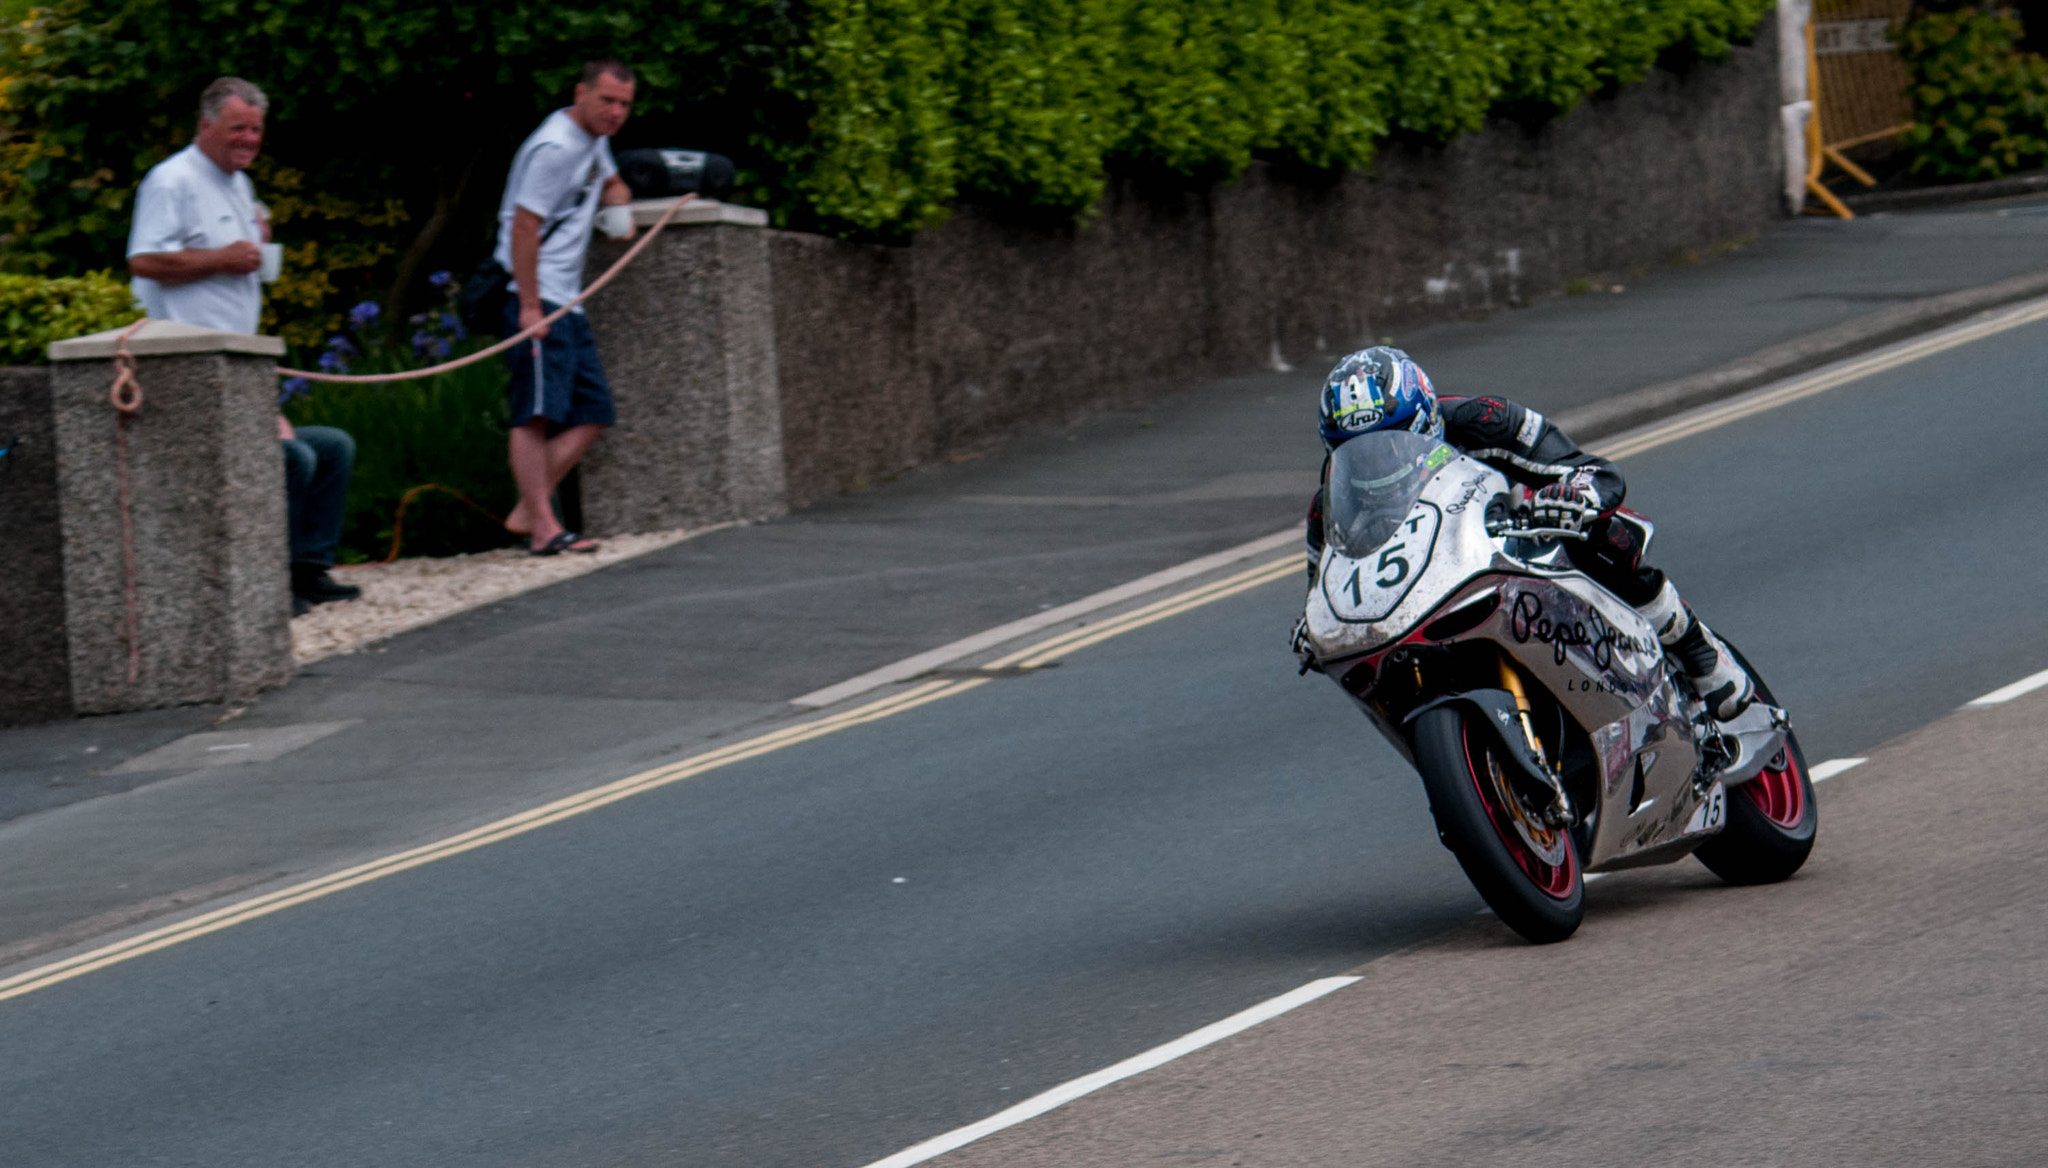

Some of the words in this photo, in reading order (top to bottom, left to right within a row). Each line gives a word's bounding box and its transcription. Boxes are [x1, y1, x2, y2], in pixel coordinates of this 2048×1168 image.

[1343, 411, 1378, 430] Arai
[1512, 591, 1591, 666] Pepe
[1589, 605, 1658, 673] Jeans
[1567, 679, 1640, 695] LONDON
[1702, 795, 1721, 829] 15
